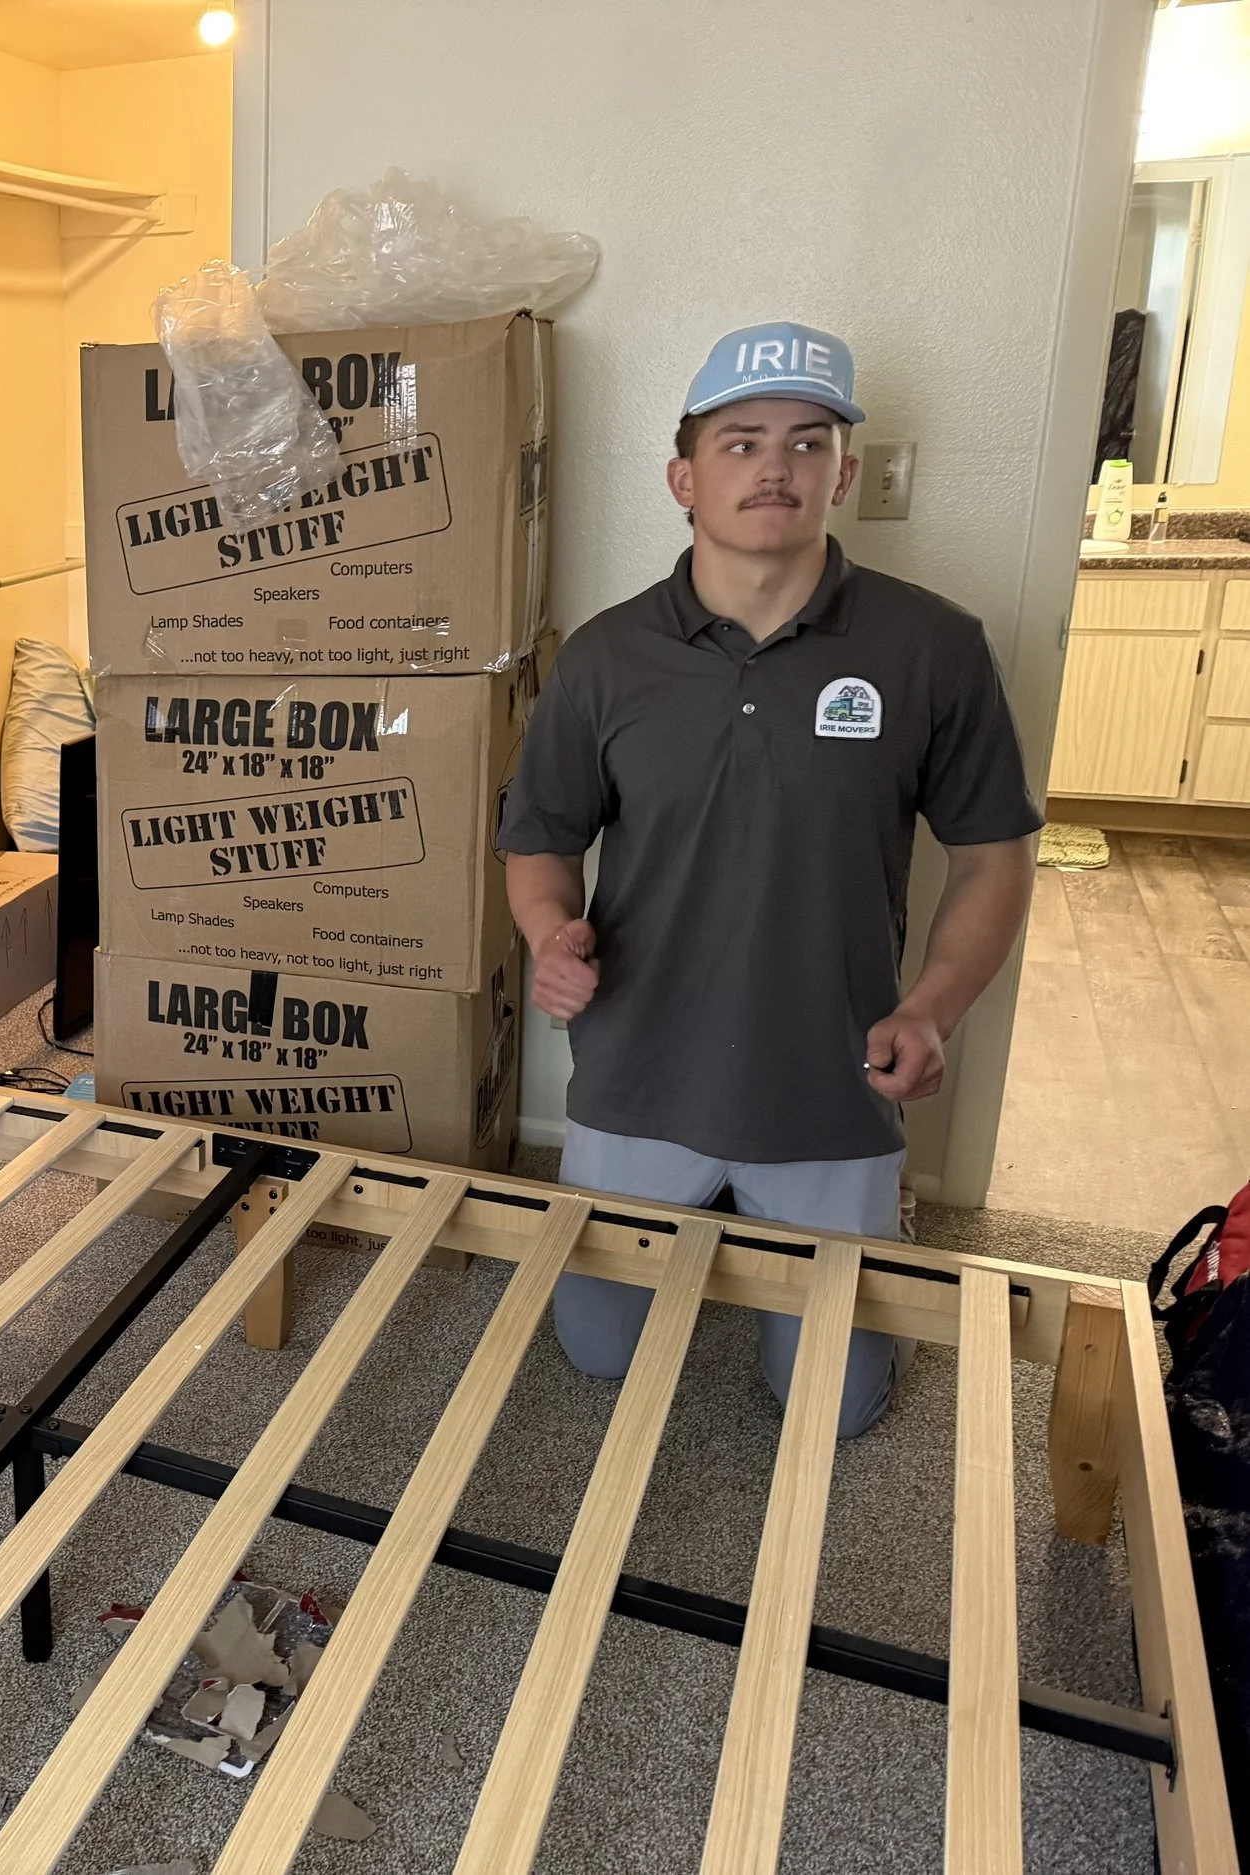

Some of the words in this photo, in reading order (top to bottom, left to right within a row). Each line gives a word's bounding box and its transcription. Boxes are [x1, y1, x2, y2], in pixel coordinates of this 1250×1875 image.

[735, 338, 832, 377] IRIE
[302, 352, 401, 410] BOX
[126, 497, 223, 547] LIGH
[217, 510, 345, 569] STUFF
[330, 561, 413, 579] Computers
[253, 586, 320, 603] Speakers
[151, 615, 188, 630] Lamp
[192, 614, 244, 629] Shades
[329, 616, 364, 630] Food
[369, 615, 450, 630] containers
[221, 651, 244, 663] too
[249, 648, 294, 665] heavy,
[300, 650, 325, 663] not
[328, 650, 353, 662] too
[357, 647, 394, 664] light,
[398, 648, 428, 664] just
[433, 646, 470, 664] right
[145, 696, 276, 748] LARGE
[286, 700, 381, 752] BOX
[819, 724, 836, 732] IRIE
[838, 725, 877, 734] MOVERS
[129, 810, 236, 847] LIGHT
[248, 788, 407, 835] WEIGHT
[209, 837, 327, 876] STUFF
[313, 881, 390, 899] Computers
[242, 895, 304, 913] Speakers
[151, 908, 185, 925] Lamp
[188, 912, 235, 928] Shades
[312, 927, 346, 942] Food
[349, 931, 424, 949] containers
[215, 946, 237, 959] too
[240, 947, 282, 965] heavy,
[286, 952, 309, 966] not
[312, 955, 335, 969] too
[339, 956, 373, 975] light,
[376, 961, 405, 976] just
[409, 964, 443, 981] right
[148, 980, 271, 1037] LARG
[282, 996, 370, 1050] BOX
[129, 1089, 235, 1117] LIGHT
[246, 1084, 395, 1115] WEIGHT
[306, 1228, 327, 1240] too
[331, 1230, 363, 1249] light,
[366, 1238, 389, 1252] jus
